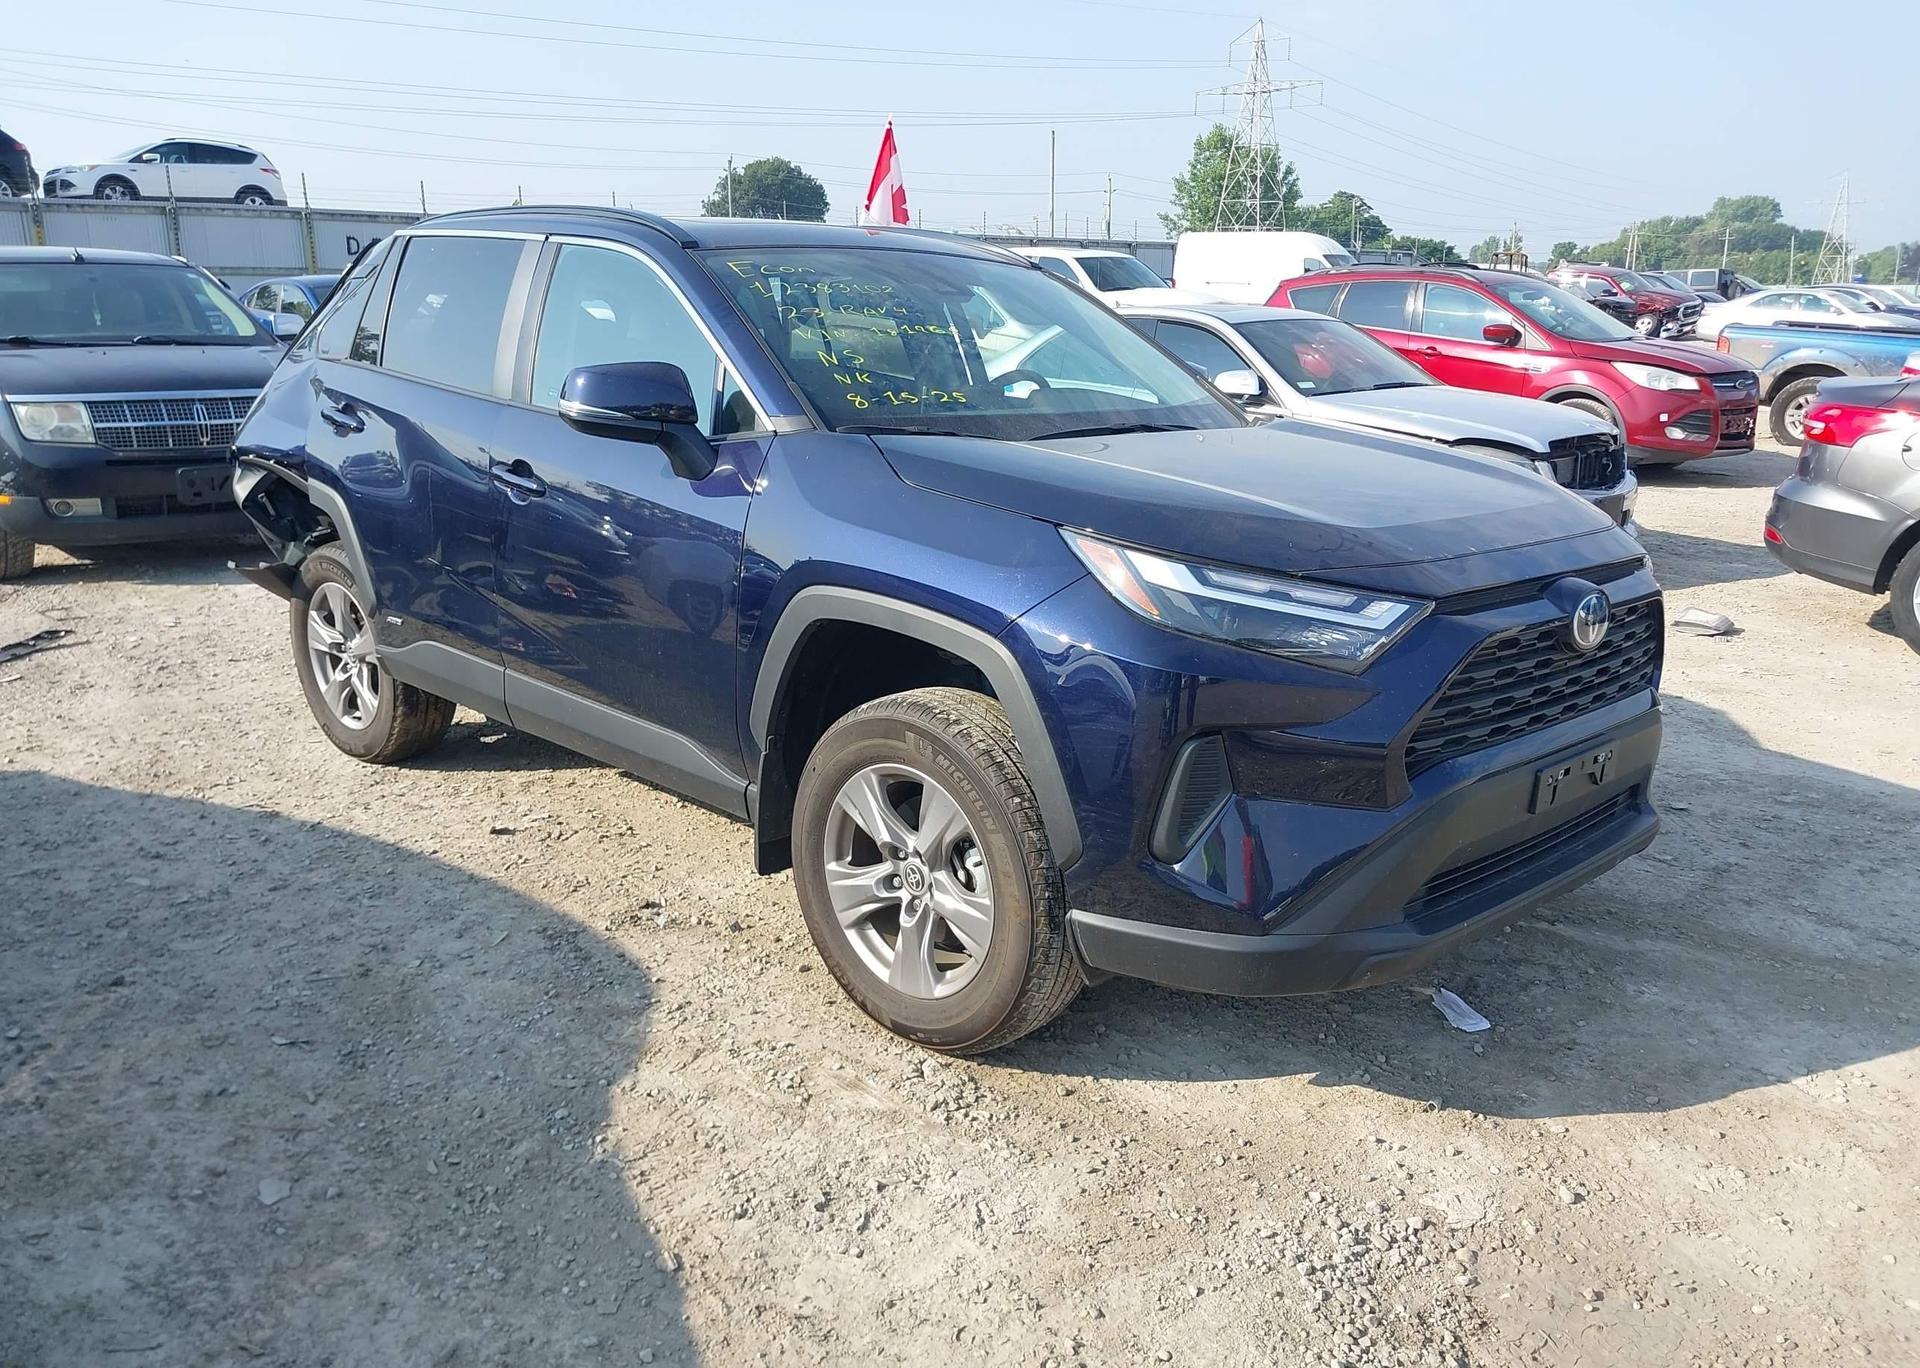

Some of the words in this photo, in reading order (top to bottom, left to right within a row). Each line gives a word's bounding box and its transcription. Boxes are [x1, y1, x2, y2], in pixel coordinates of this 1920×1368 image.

[779, 305, 825, 319] 23
[817, 349, 865, 367] NS
[833, 372, 873, 385] NK
[847, 390, 968, 409] 8-15-25
[935, 754, 1000, 831] MICHELIN
